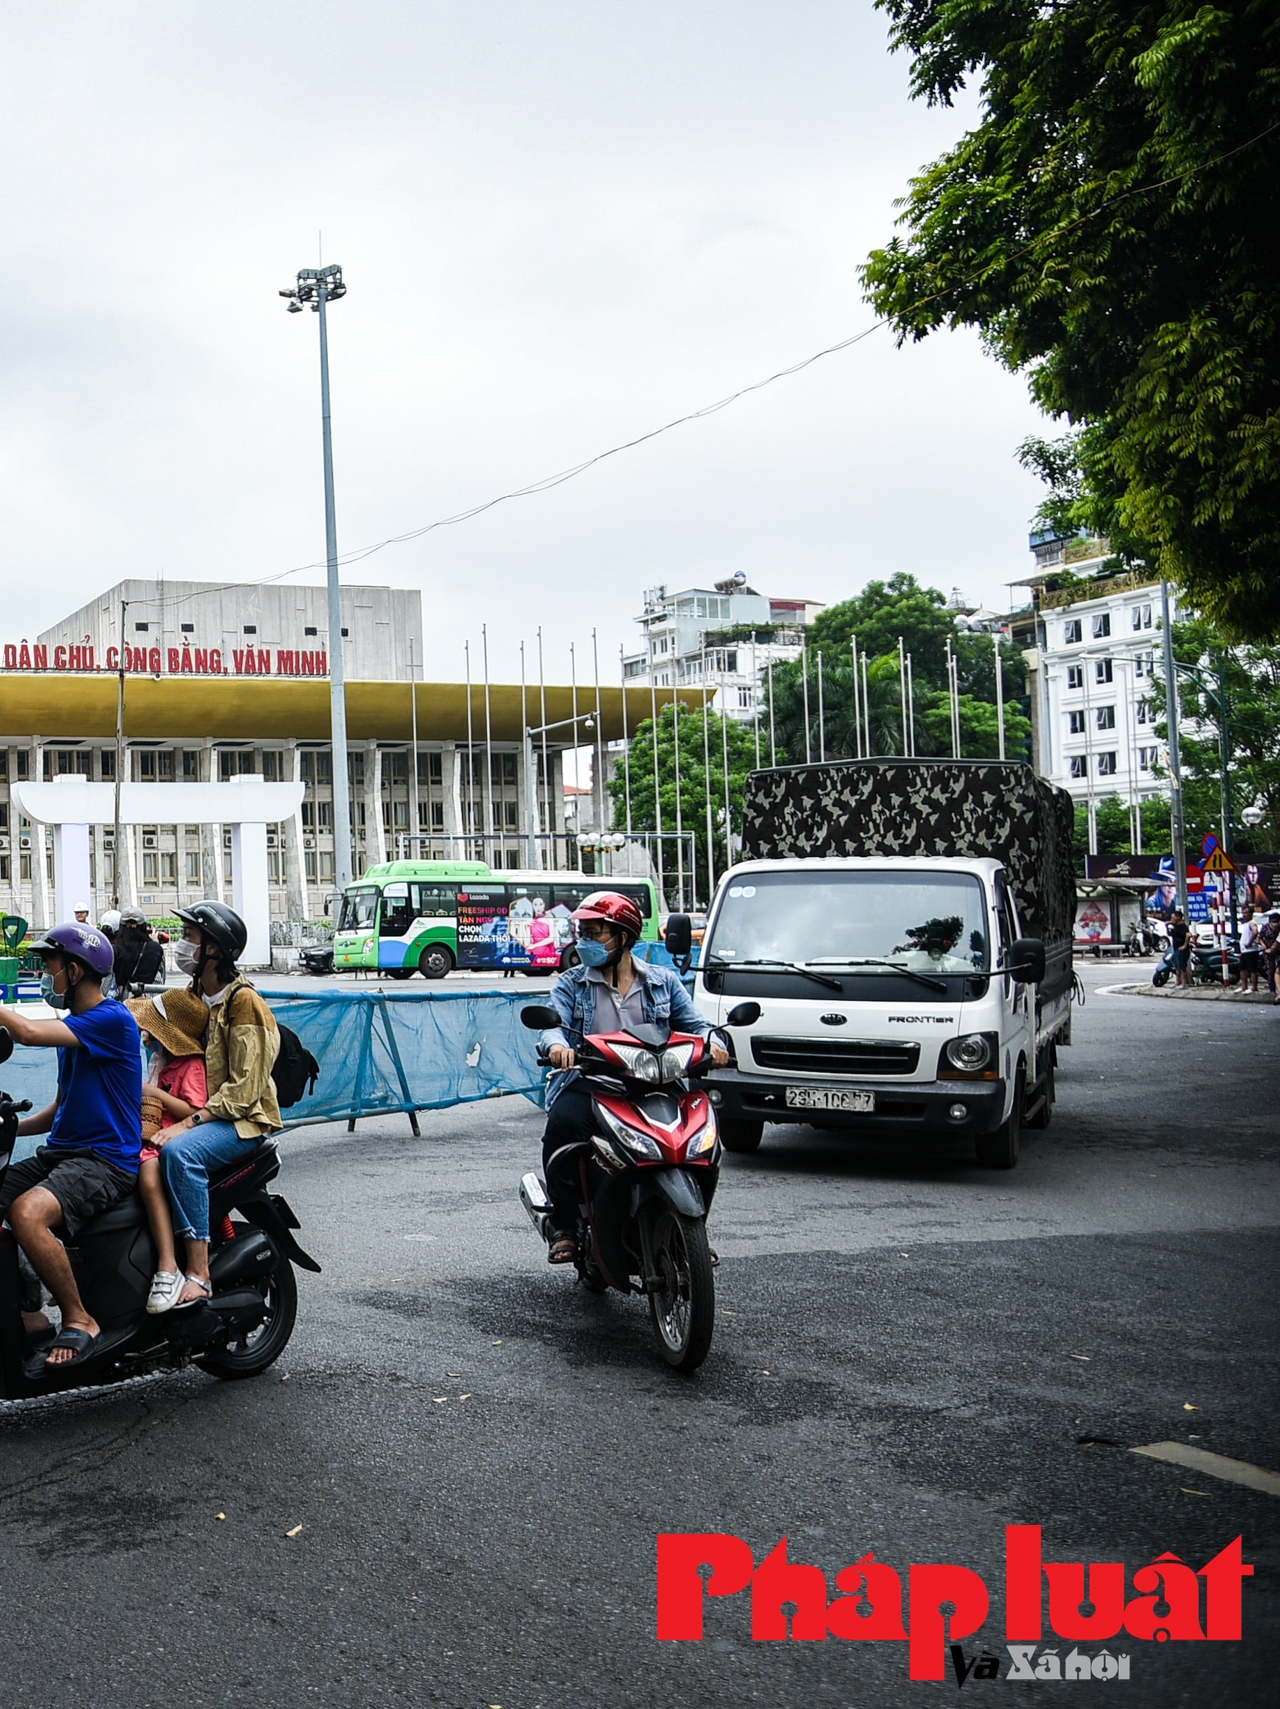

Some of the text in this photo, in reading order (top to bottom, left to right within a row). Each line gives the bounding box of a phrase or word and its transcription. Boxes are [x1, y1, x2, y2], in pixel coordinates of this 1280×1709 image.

[4, 639, 48, 670] DÂN
[54, 634, 102, 674] CHỦ,
[106, 641, 161, 672] CÔNG
[167, 637, 229, 676] BẰNG,
[232, 643, 271, 674] VĂN
[457, 906, 495, 914] FREESHIP
[458, 925, 483, 935] CHỌN
[458, 934, 490, 943] LAZADA
[887, 1015, 954, 1024] FRONTIER
